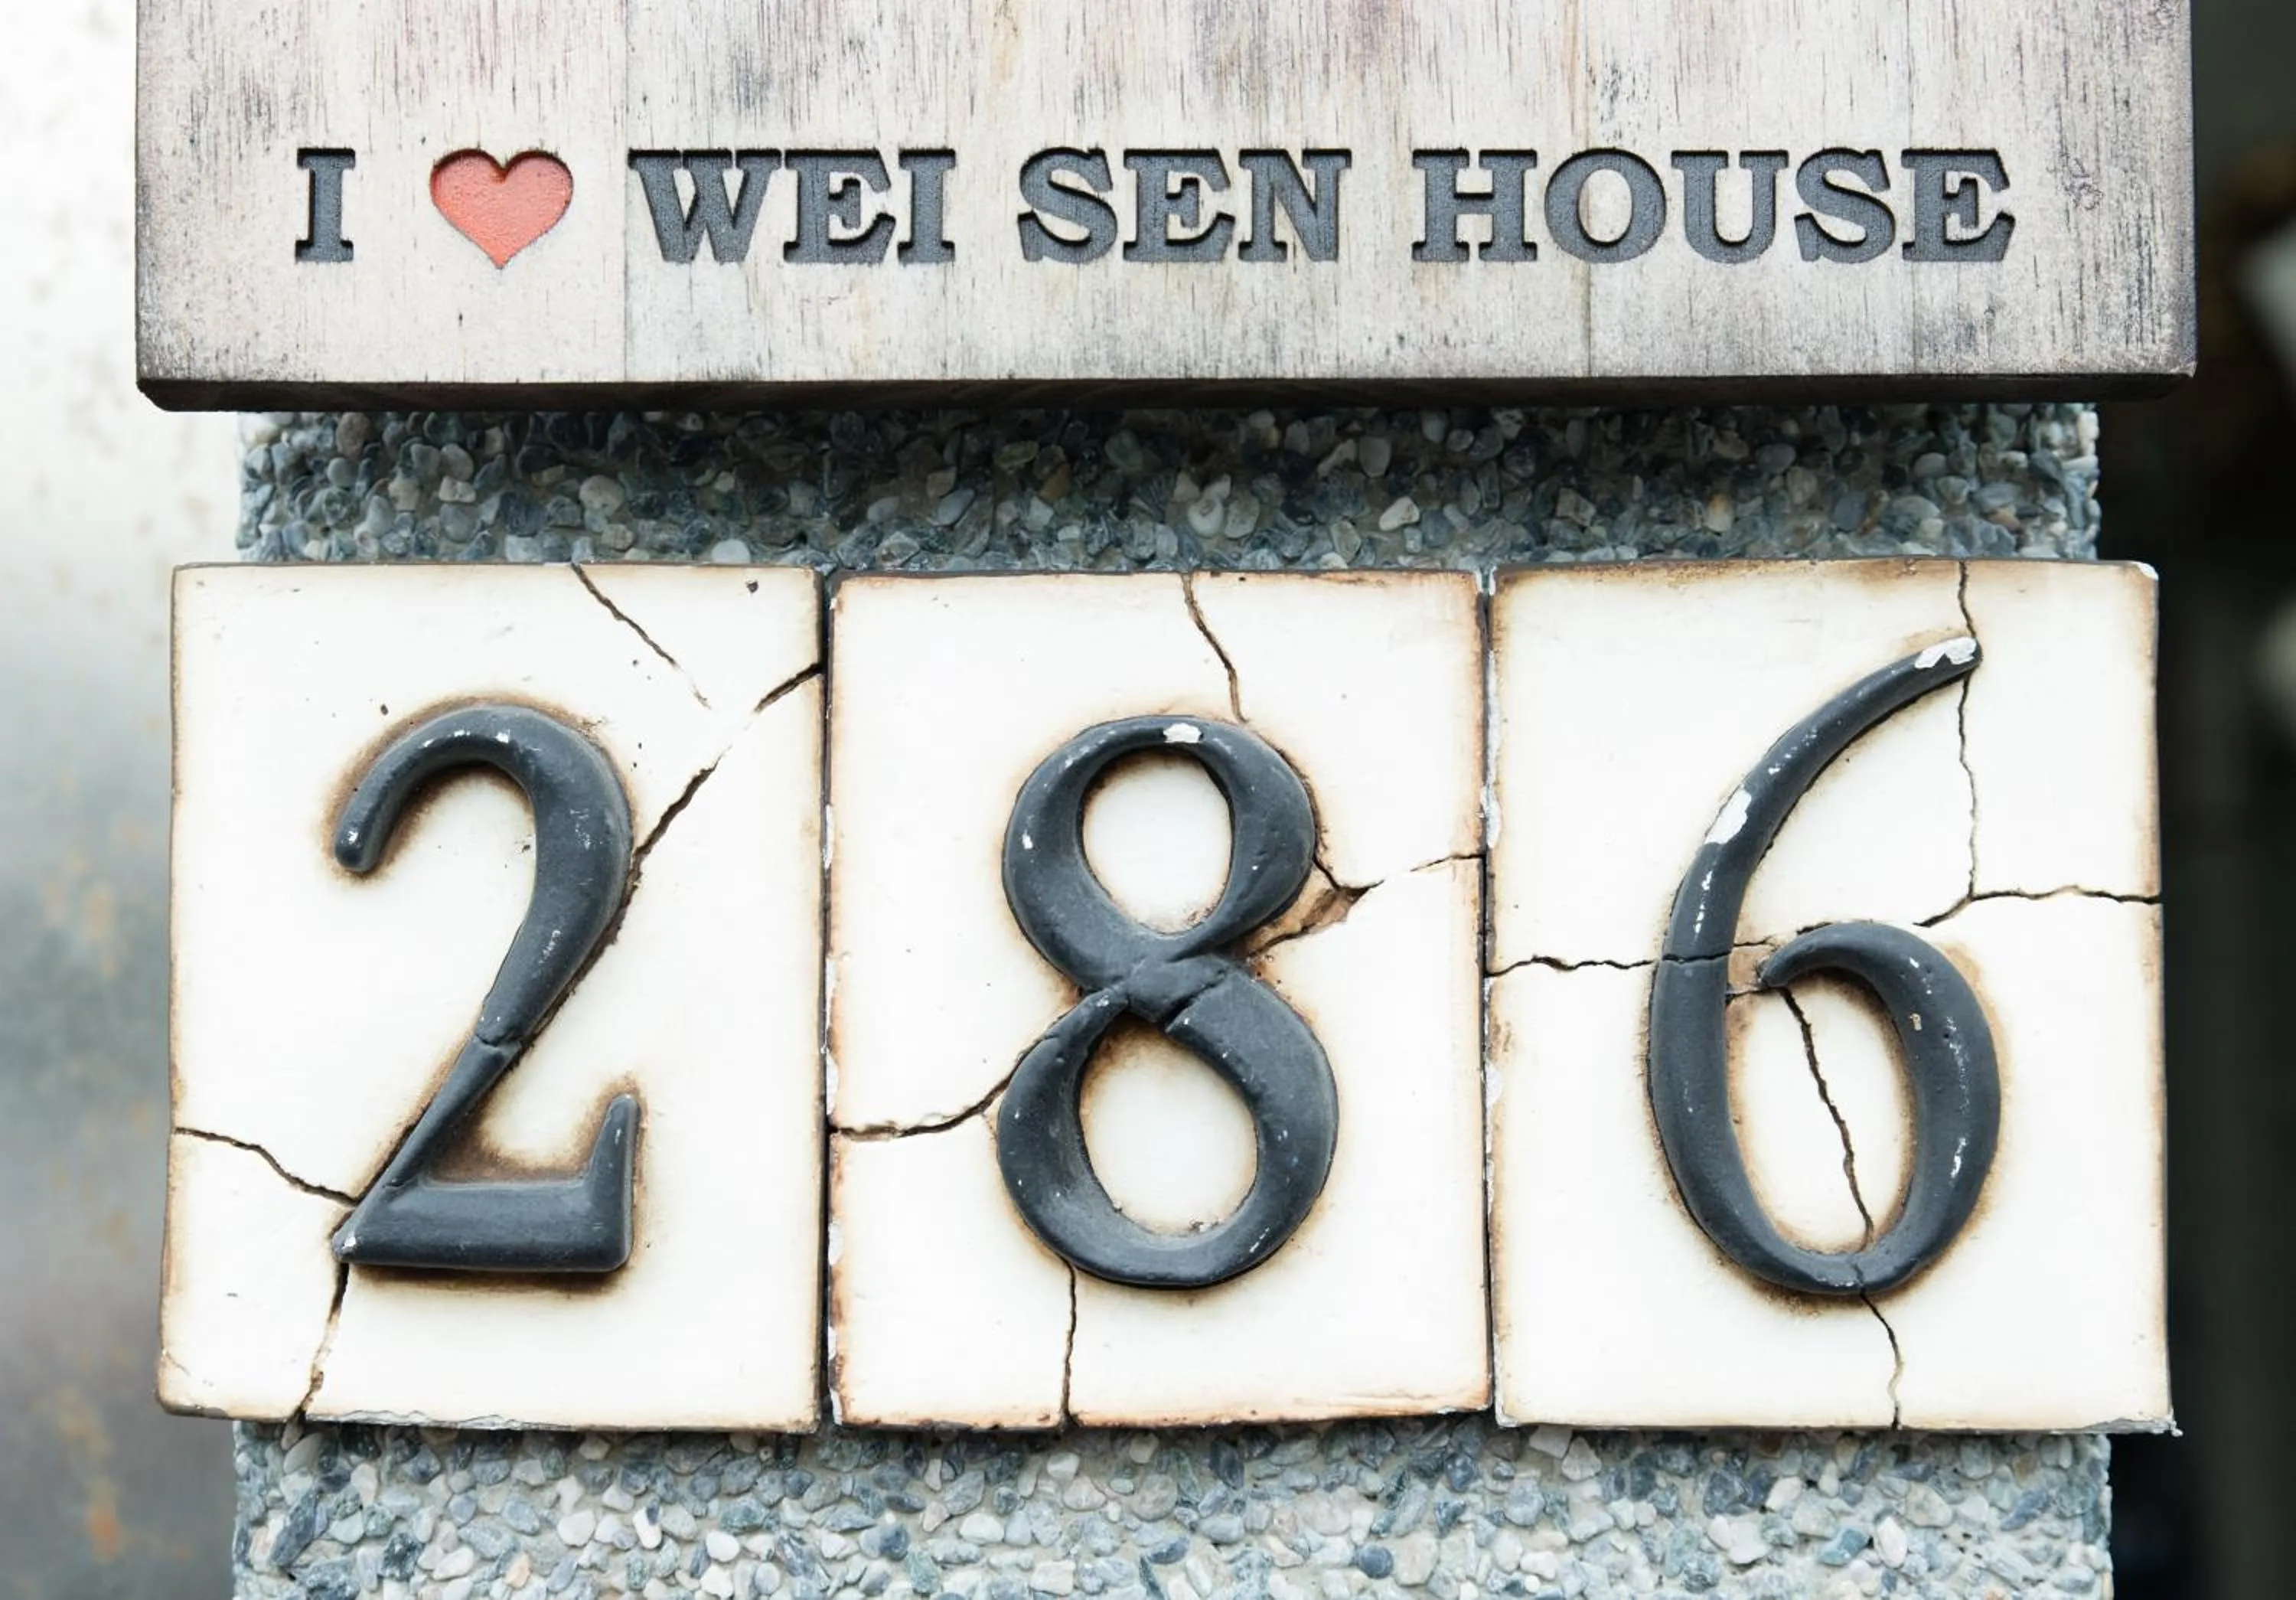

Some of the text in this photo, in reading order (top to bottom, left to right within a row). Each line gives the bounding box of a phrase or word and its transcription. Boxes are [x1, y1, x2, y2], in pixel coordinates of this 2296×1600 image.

[295, 145, 2017, 264] I WEI SEN HOUSE
